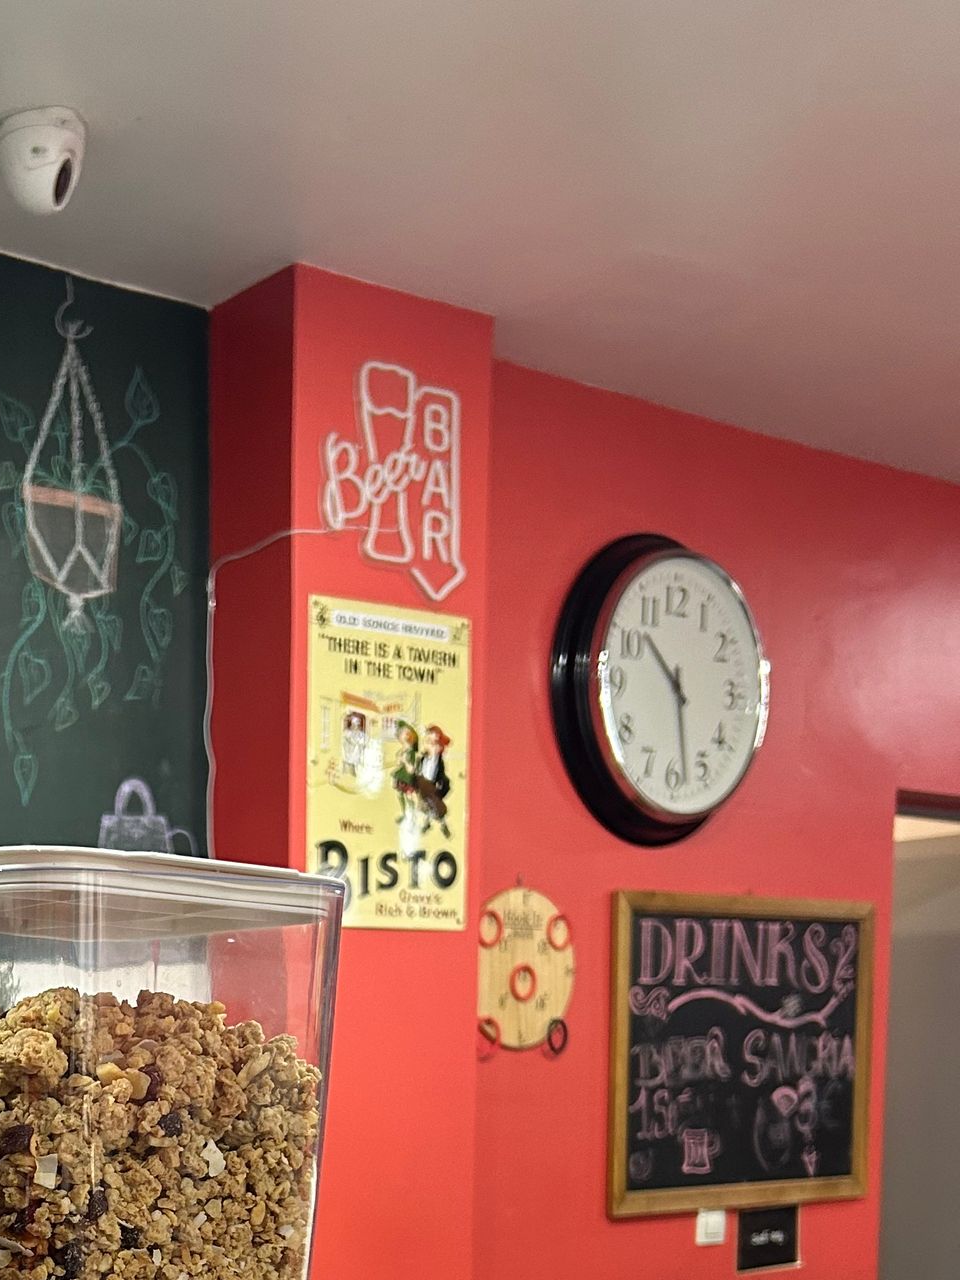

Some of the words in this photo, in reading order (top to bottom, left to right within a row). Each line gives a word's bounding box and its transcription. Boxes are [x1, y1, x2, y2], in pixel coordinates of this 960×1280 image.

[323, 431, 426, 530] Beer
[421, 403, 450, 563] BAR
[640, 595, 660, 627] 11
[665, 585, 689, 618] 12
[374, 641, 390, 659] IS
[392, 645, 403, 660] A
[407, 645, 459, 668] TAVERN
[620, 628, 642, 661] 10
[713, 632, 728, 663] 2
[344, 658, 360, 675] IN
[365, 659, 392, 680] THE
[609, 666, 627, 698] 9
[618, 713, 635, 744] 8
[641, 747, 656, 778] 7
[665, 758, 681, 792] 6
[339, 818, 373, 834] Where
[637, 917, 829, 994] DRINKS
